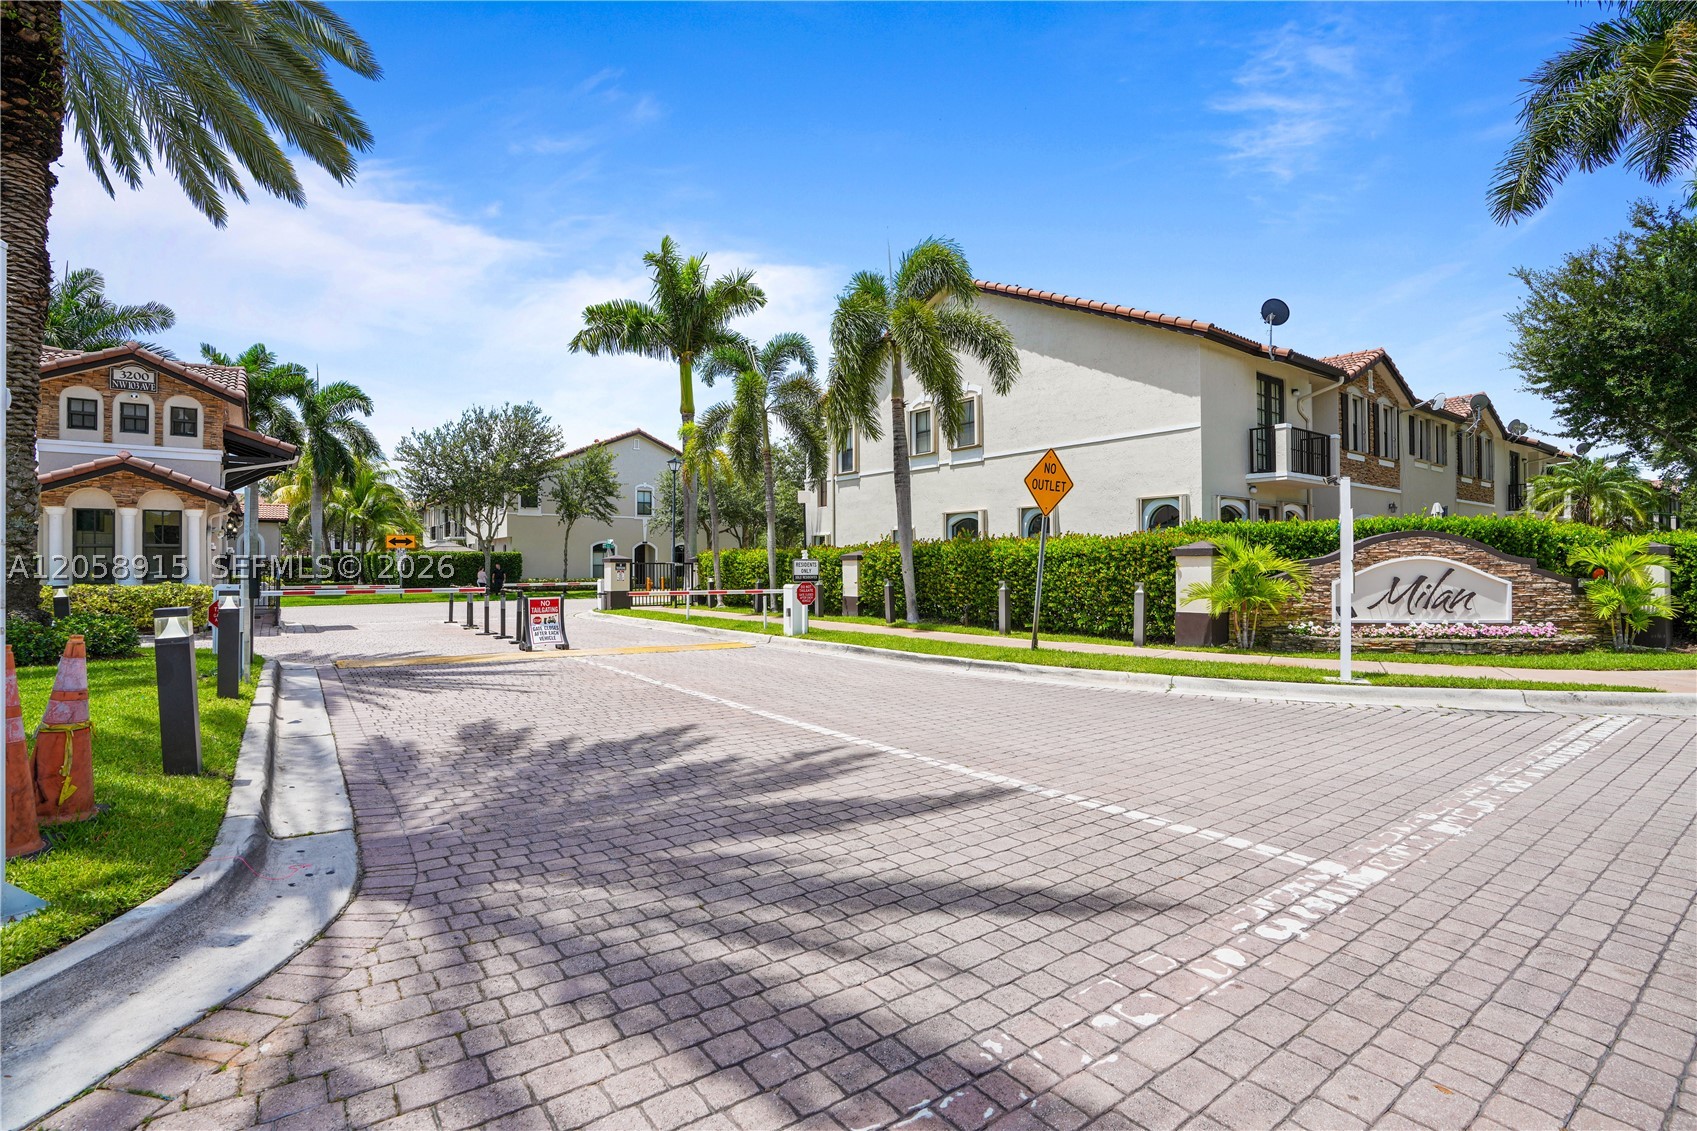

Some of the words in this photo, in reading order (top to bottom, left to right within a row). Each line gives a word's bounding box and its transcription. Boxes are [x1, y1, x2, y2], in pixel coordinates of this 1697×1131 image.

[120, 370, 149, 381] 3200
[112, 380, 128, 389] NW
[128, 382, 140, 390] 103
[141, 383, 156, 391] AVE
[1044, 462, 1057, 475] NO
[1032, 478, 1067, 492] OUTLET
[1367, 568, 1477, 615] Milan
